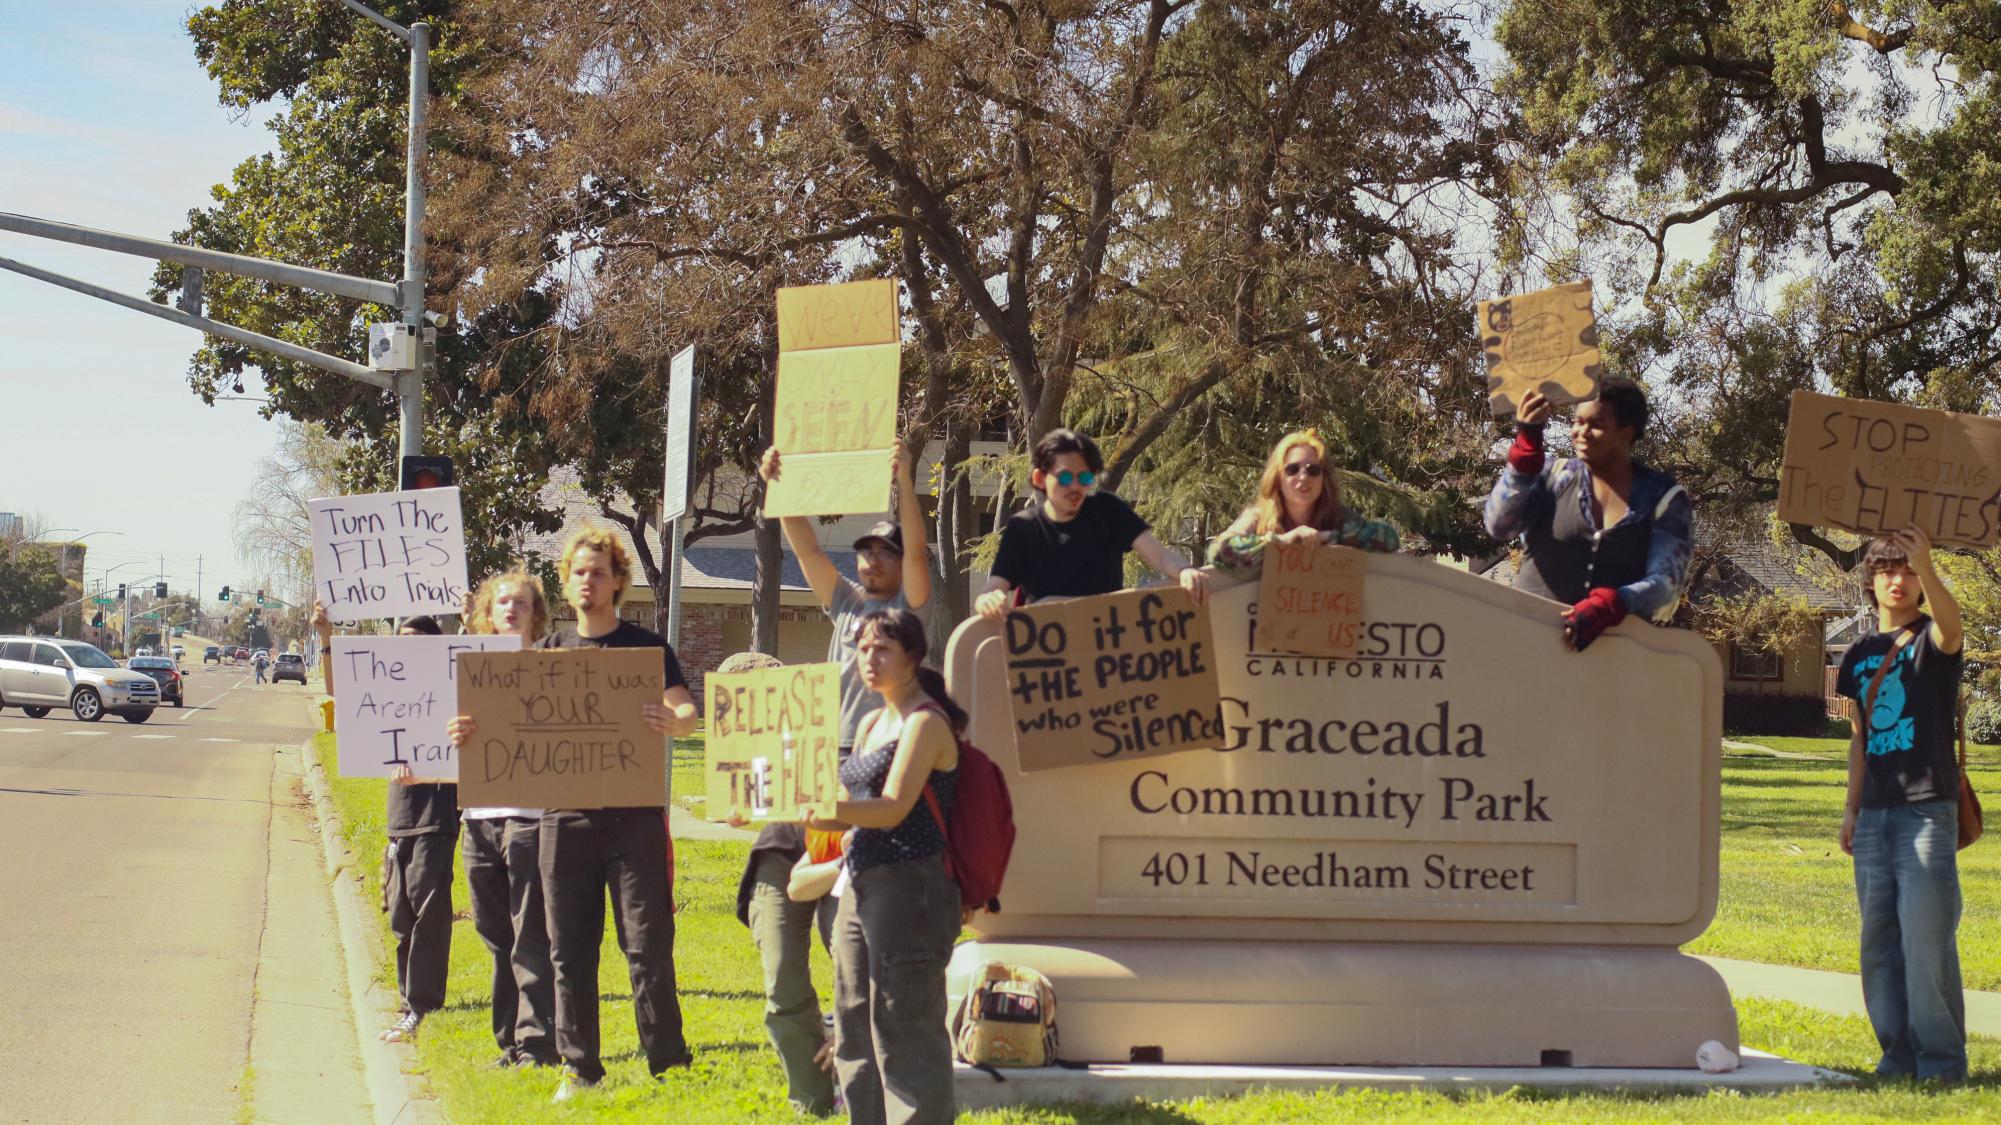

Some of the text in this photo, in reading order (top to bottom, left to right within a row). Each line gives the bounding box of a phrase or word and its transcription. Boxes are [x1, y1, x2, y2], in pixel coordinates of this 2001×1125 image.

[782, 352, 883, 394] ONLY
[782, 397, 888, 451] SEEN
[1819, 411, 1931, 455] STOP
[319, 500, 449, 535] Turn The
[1784, 466, 2000, 541] The ELITES
[329, 534, 450, 573] FILES
[1276, 543, 1314, 576] YOU
[322, 571, 465, 610] Into Trials
[1275, 585, 1360, 615] SILENCE
[1093, 605, 1126, 651] it
[1136, 592, 1195, 644] for
[1328, 621, 1358, 649] US
[345, 650, 406, 682] The
[463, 656, 529, 690] What
[539, 660, 563, 692] if
[574, 661, 597, 689] it
[608, 672, 658, 691] was
[1094, 641, 1206, 689] PEOPLE
[1246, 660, 1444, 680] CALIFORNIA
[356, 691, 437, 719] Aren't
[519, 691, 606, 724] YOUR
[713, 669, 826, 738] RELEASE
[1017, 692, 1160, 734] who were
[1091, 702, 1226, 759] Silenced
[1210, 696, 1487, 758] Graceada
[483, 738, 641, 784] DAUGHTER
[716, 760, 775, 809] THE
[1130, 770, 1553, 829] Community Park
[1141, 850, 1535, 890] 401 Needham Street
